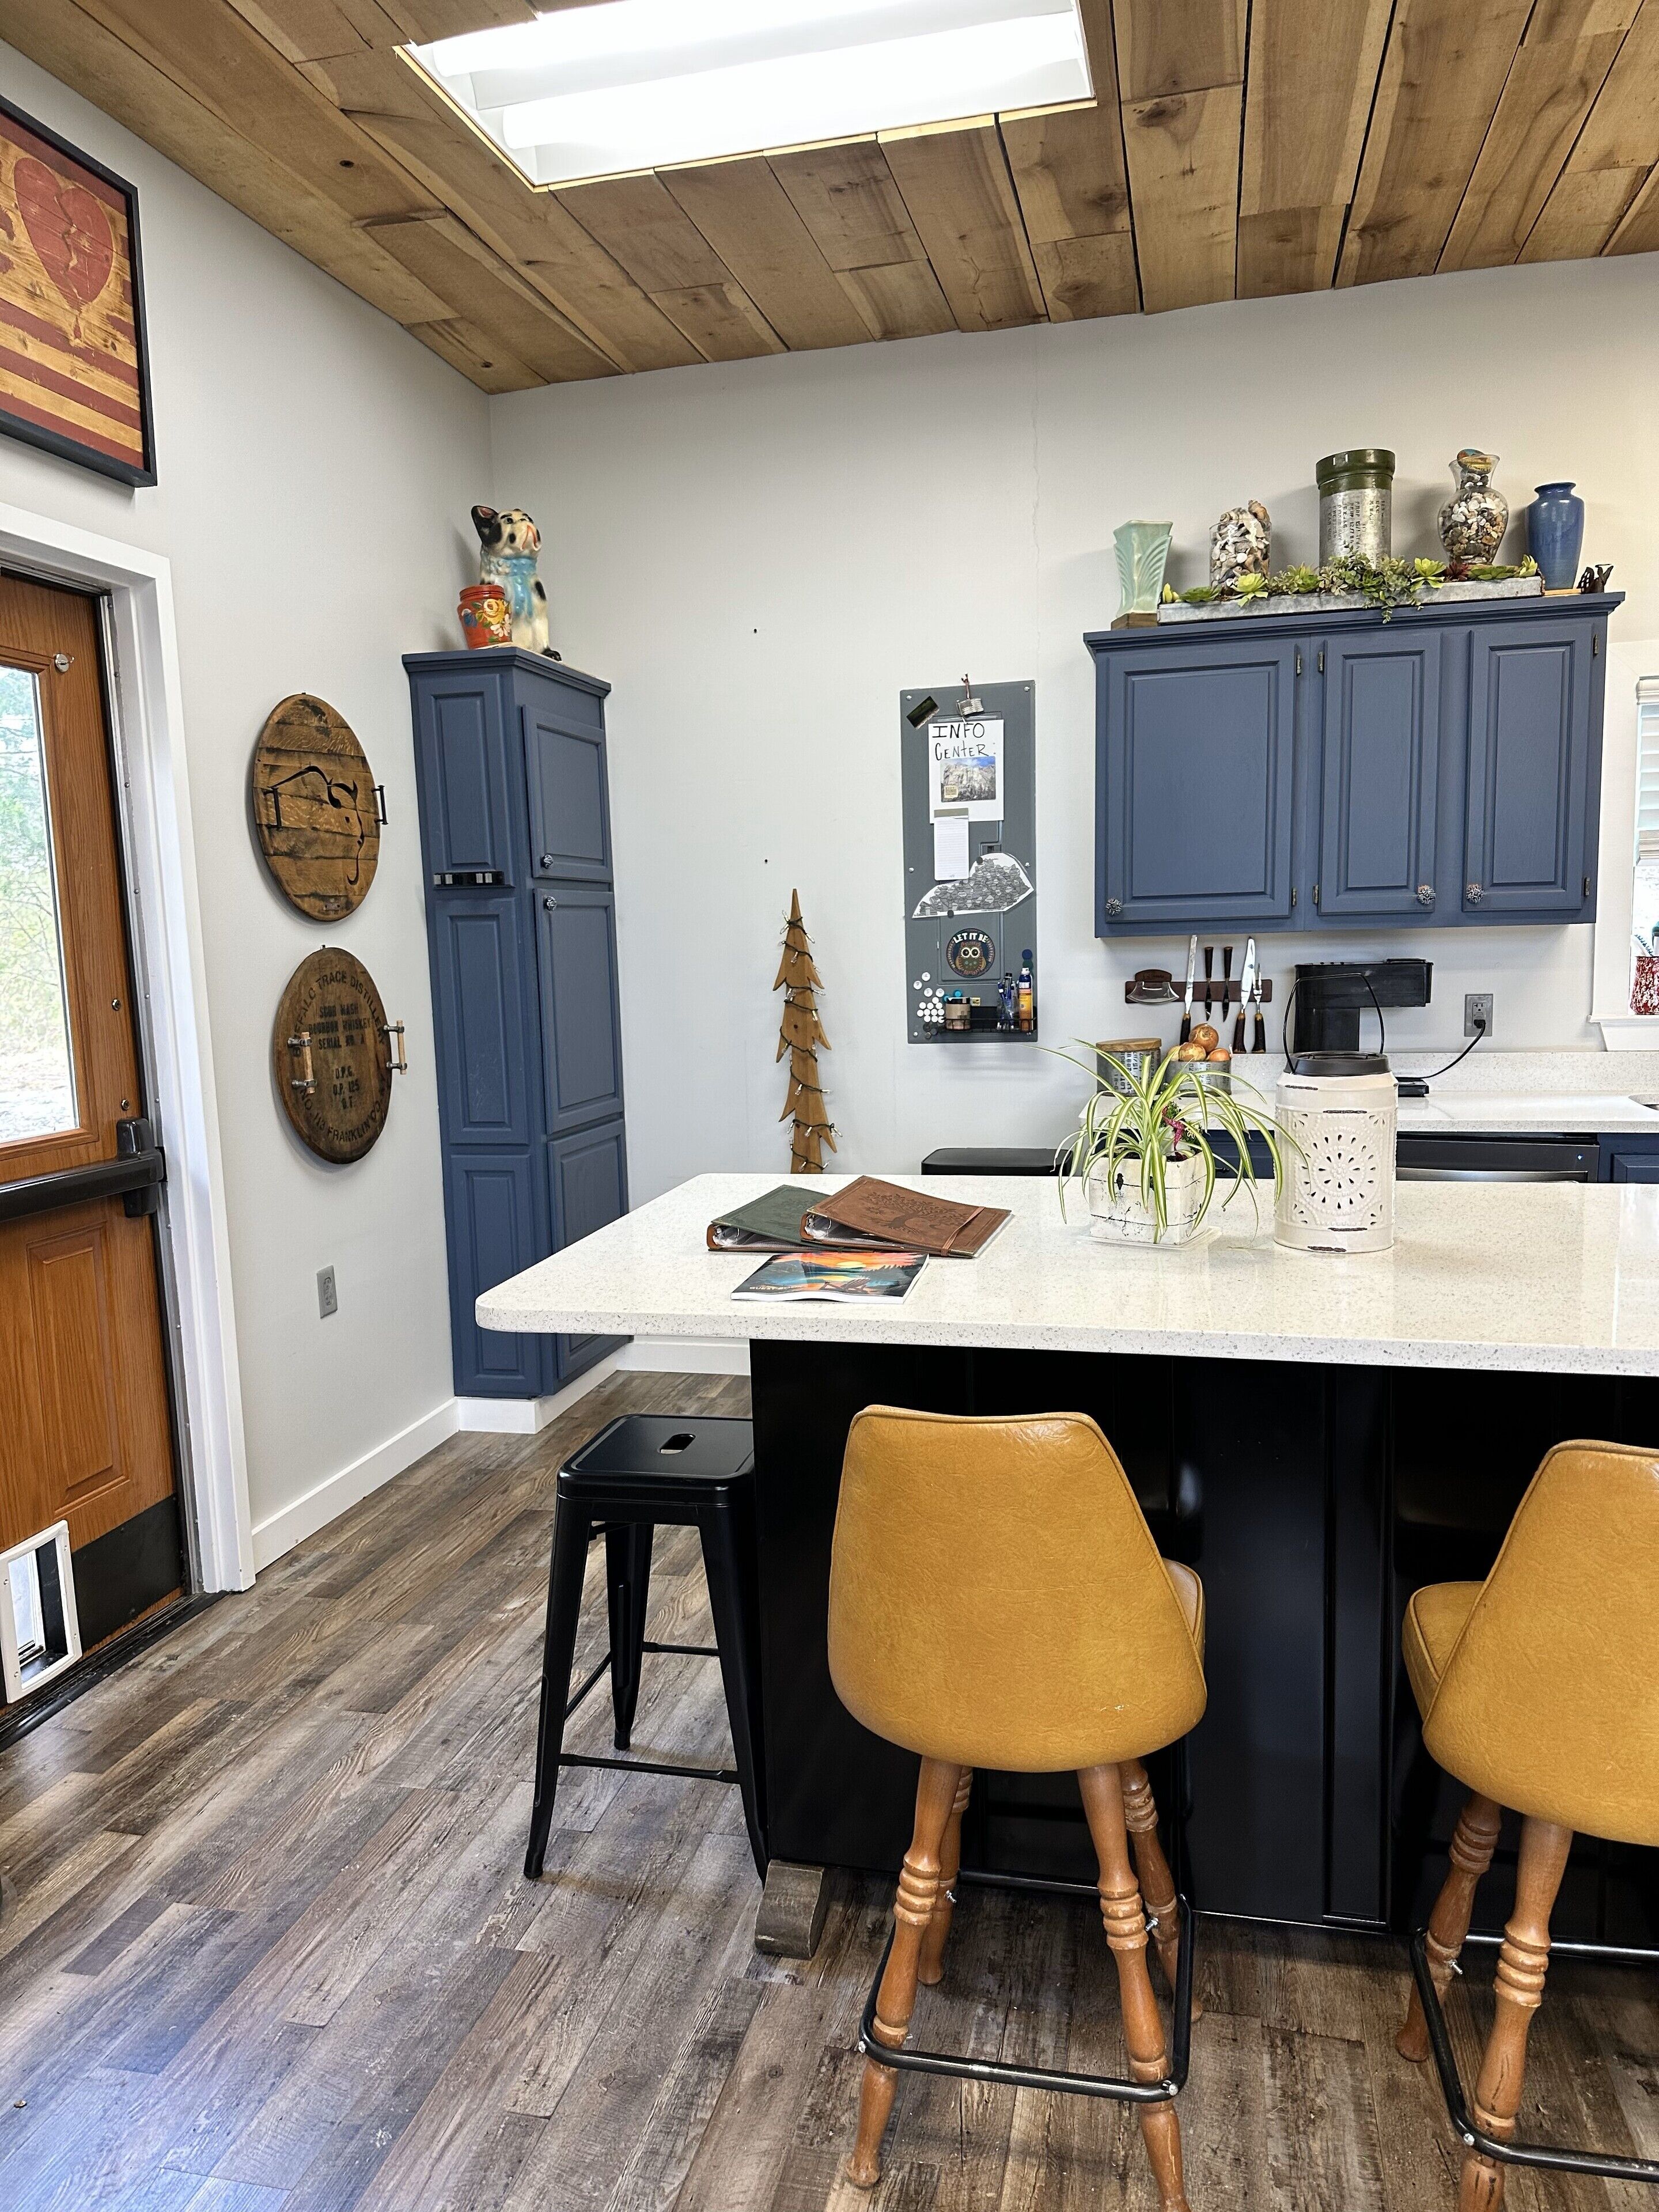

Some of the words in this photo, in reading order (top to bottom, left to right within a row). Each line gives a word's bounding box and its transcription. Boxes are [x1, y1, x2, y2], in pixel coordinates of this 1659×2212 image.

[932, 723, 985, 739] INFO
[953, 933, 968, 944] LET
[978, 933, 988, 943] BE
[315, 970, 347, 991] TRACE
[342, 1017, 372, 1031] WHISKEY
[318, 1036, 342, 1050] SERIAL
[327, 1118, 371, 1143] FRANKLIN
